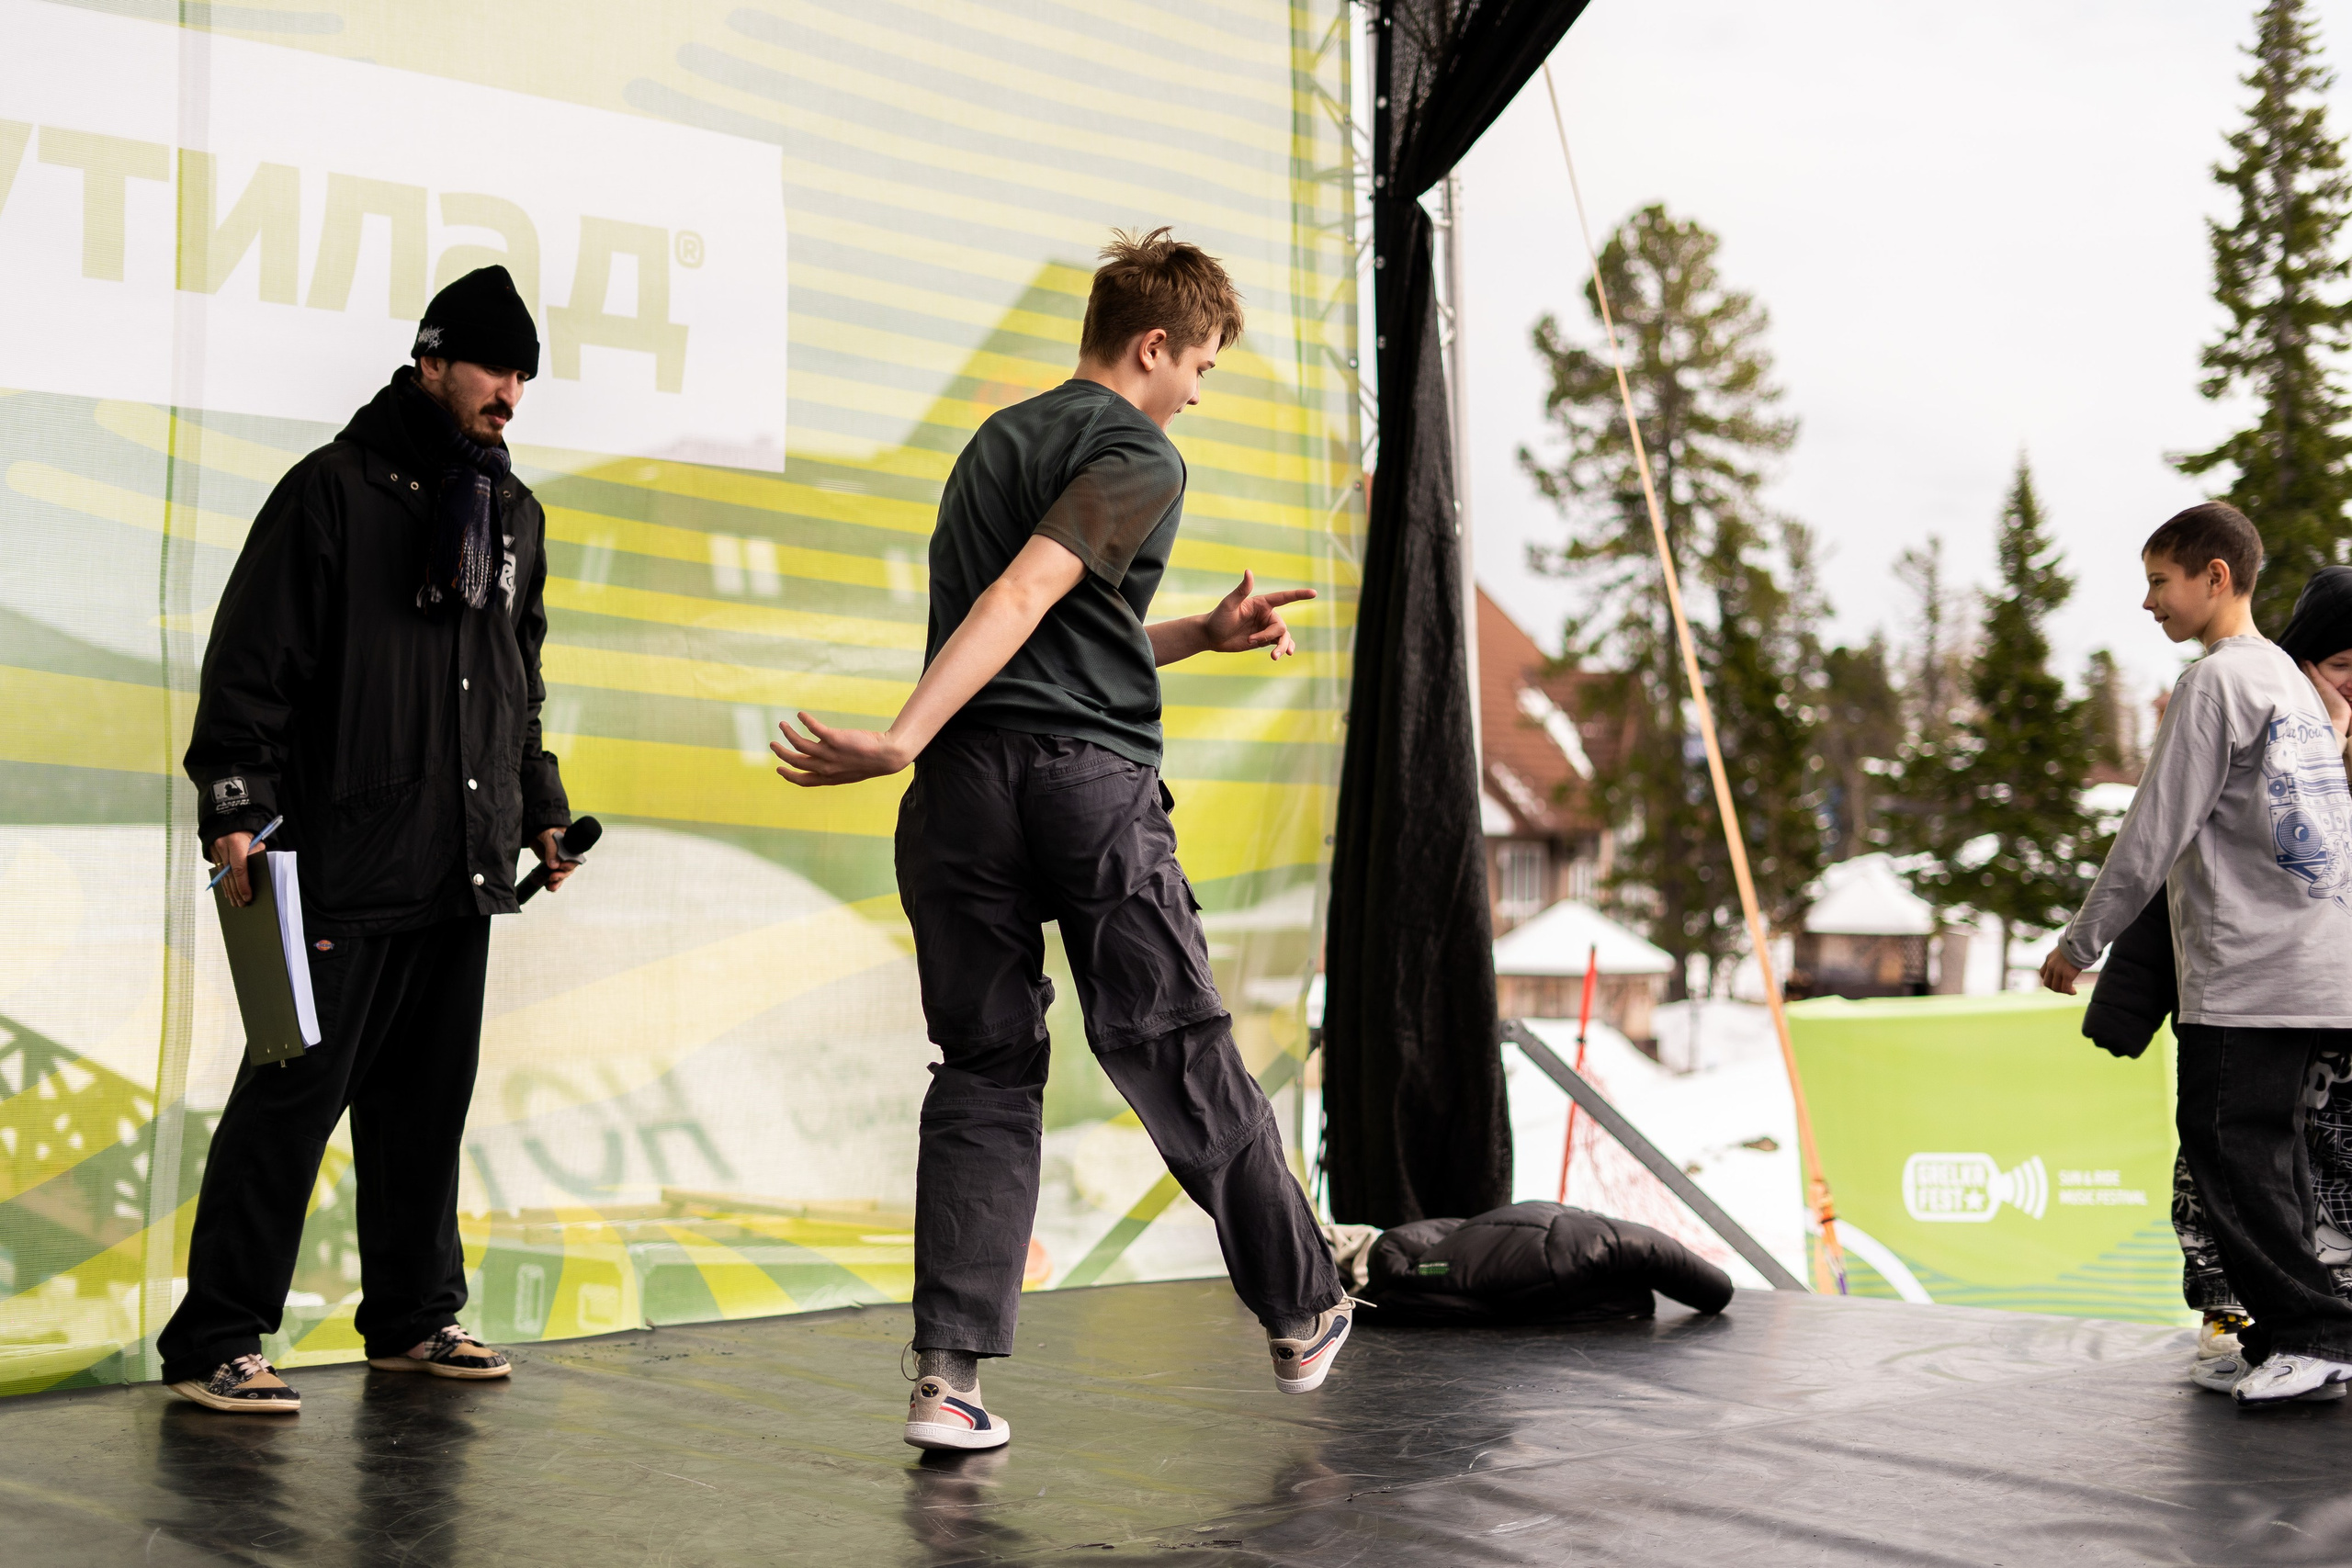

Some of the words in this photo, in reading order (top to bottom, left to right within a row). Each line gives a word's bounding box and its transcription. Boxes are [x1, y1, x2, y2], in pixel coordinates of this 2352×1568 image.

[2058, 1169, 2082, 1186] SUN
[2095, 1169, 2121, 1186] RIDE
[1917, 1189, 1962, 1211] FEST
[2058, 1189, 2096, 1205] MUSIC
[2097, 1189, 2148, 1206] FESTIVAL
